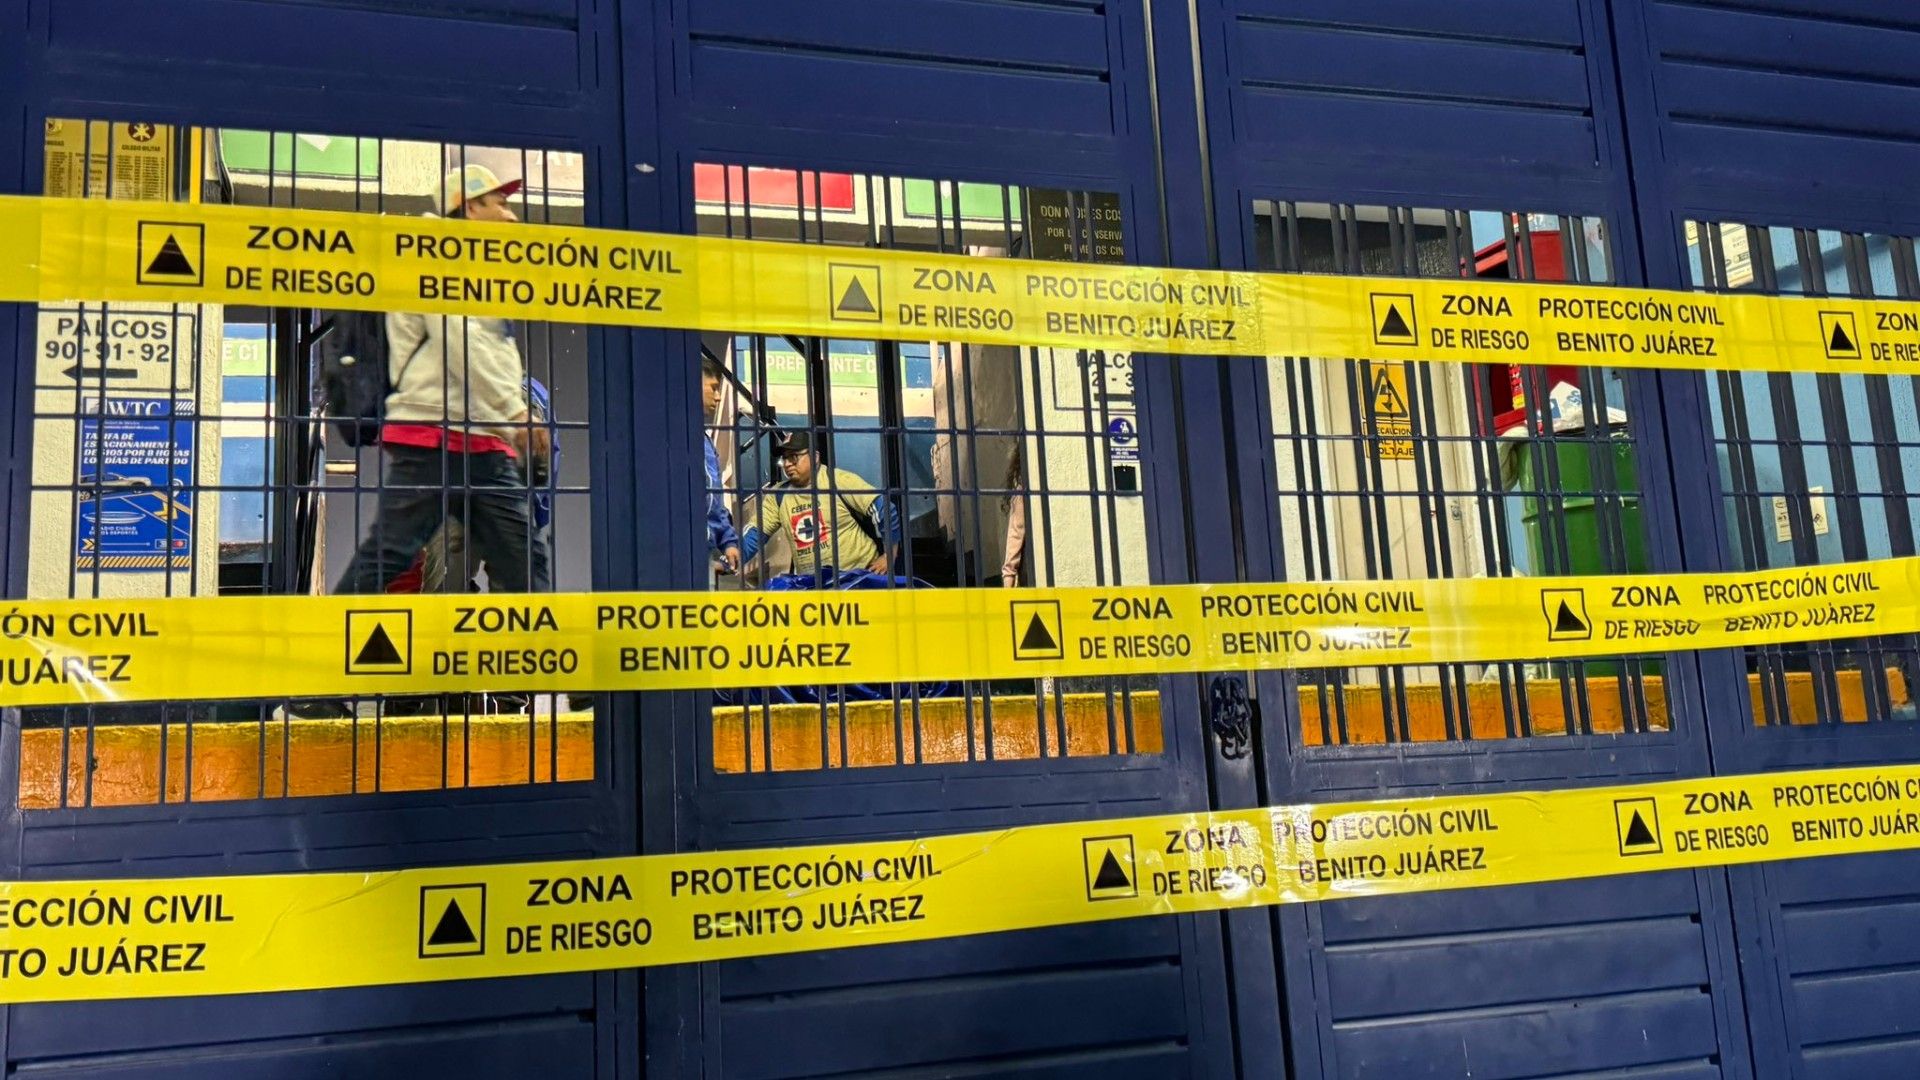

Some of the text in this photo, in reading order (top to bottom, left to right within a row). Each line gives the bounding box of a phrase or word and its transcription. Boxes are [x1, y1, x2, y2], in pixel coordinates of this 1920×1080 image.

[248, 226, 354, 253] ZONA
[1047, 227, 1064, 238] POR
[397, 234, 680, 273] PROTECCIÓN CIVIL
[226, 267, 374, 295] DE RIESGO
[420, 276, 661, 310] BENITO JUÁREZ
[913, 268, 995, 294] ZONA
[1026, 275, 1250, 307] PROTECCIÓN CIVIL
[899, 303, 1013, 331] DE RIESGO
[1442, 295, 1511, 316] ZONA
[1540, 298, 1723, 325] PROTECCIÓN CIVIL
[57, 317, 167, 339] PALCOS
[1047, 312, 1236, 340] BENITO JUÁREZ
[1432, 328, 1529, 350] DE RIESGO
[1557, 333, 1716, 356] BENITO JUÁREZ
[1870, 342, 1892, 361] DE
[108, 400, 161, 416] WTC
[84, 432, 134, 440] TAIFA DE
[83, 448, 97, 456] DE
[124, 449, 145, 457] POR
[104, 455, 130, 464] DÍAS
[131, 456, 143, 465] DE
[144, 456, 189, 465] PARTDO
[1378, 447, 1414, 456] OLTAJE
[1612, 586, 1680, 607] ZONA
[1703, 572, 1879, 604] PROTECCIÓN CIVIL
[598, 597, 868, 630] PROTECCIÓN CIVIL
[1093, 598, 1172, 620] ZONA
[1201, 587, 1423, 618] PROTECCIÓN CIVIL
[69, 613, 158, 636] CIVIL
[454, 607, 558, 632] ZONA
[1606, 620, 1700, 639] DE RIESGO
[1726, 602, 1876, 631] BENITO JUÁREZ
[1080, 635, 1190, 659] DE RIESGO
[1223, 631, 1310, 653] BENITO
[0, 650, 131, 686] UÁREZ
[434, 649, 577, 675] DE RIESGO
[621, 639, 850, 672] BENITO JUÁREZ
[1685, 791, 1752, 814] ZONA
[1773, 775, 1900, 808] PROTECCIÓN
[1275, 808, 1497, 845] PROTECCIÓN CIVIL
[1675, 825, 1768, 851] DE RIESGO
[1792, 817, 1863, 842] BENITO
[1165, 825, 1247, 855] ZONA
[671, 855, 941, 897] PROTECCIÓN CIVIL
[1299, 845, 1486, 884] BENITO JUÁREZ
[527, 875, 632, 906] ZONA
[1153, 871, 1182, 895] DE
[145, 895, 233, 923] CIVIL
[694, 894, 924, 940] BENITO JUÁREZ
[507, 918, 651, 954] DE RIESGO
[58, 938, 205, 976] JUÁREZ
